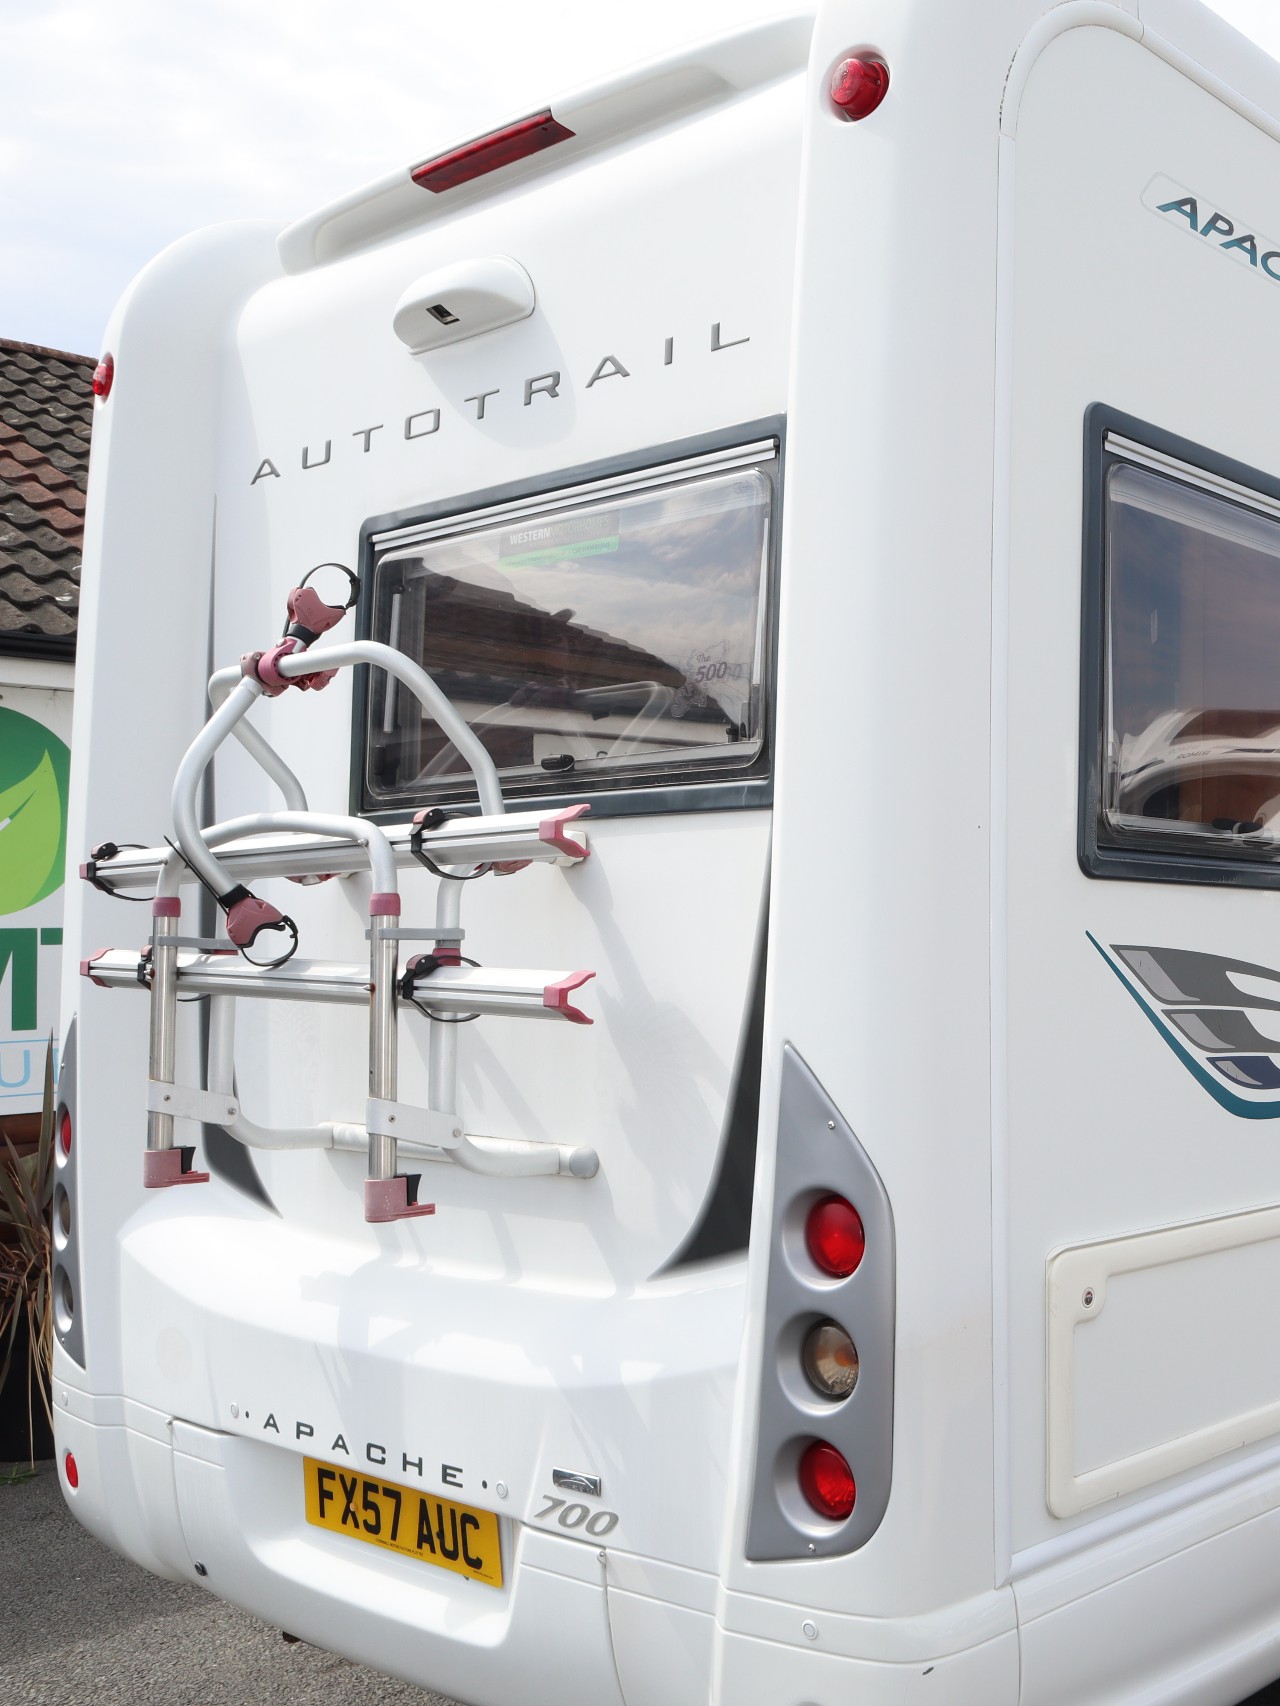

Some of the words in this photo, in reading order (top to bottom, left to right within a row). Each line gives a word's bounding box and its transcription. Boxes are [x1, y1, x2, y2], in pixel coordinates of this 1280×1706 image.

[250, 321, 750, 485] AUTOTRAIL
[509, 526, 551, 545] WESTERN
[694, 660, 728, 683] 500
[264, 1413, 463, 1488] APACHE
[318, 1467, 401, 1542] FX57
[416, 1503, 483, 1572] AUC
[533, 1494, 620, 1537] 700
